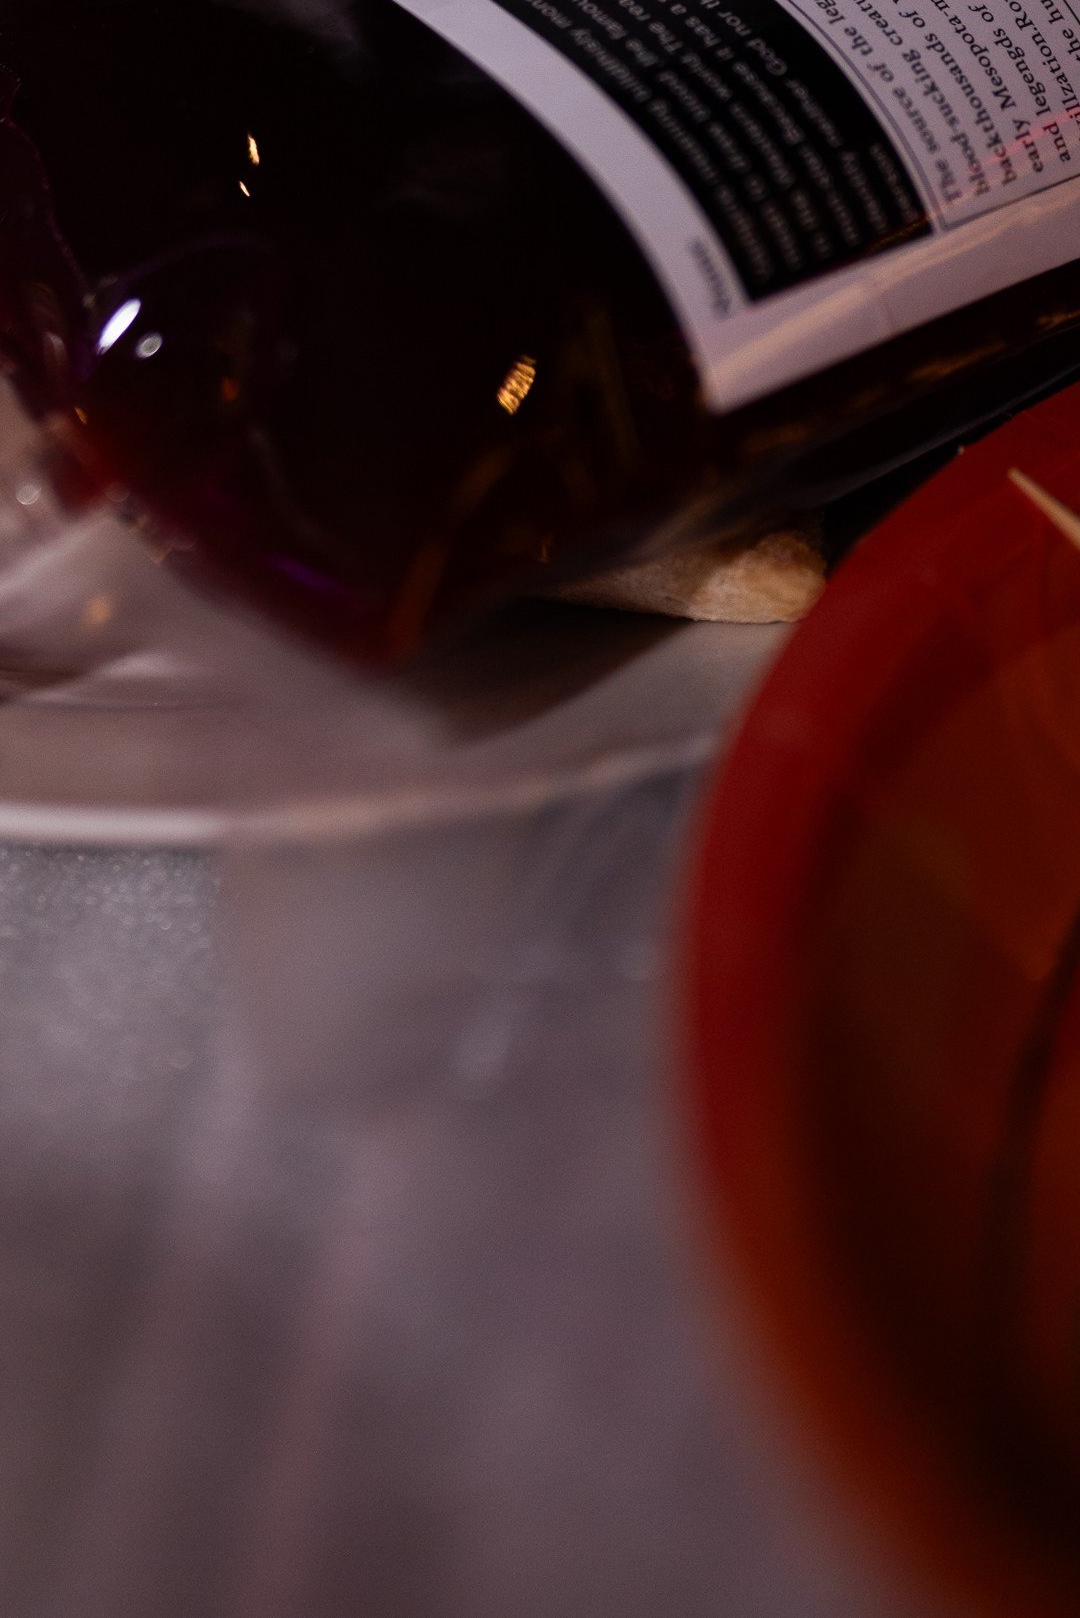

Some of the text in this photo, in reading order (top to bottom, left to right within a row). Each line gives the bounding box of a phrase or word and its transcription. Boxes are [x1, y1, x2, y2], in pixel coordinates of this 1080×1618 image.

[671, 4, 686, 14] a
[718, 12, 751, 36] nor
[899, 11, 925, 28] of
[968, 5, 994, 22] of
[685, 16, 719, 47] has
[844, 27, 873, 56] the
[746, 38, 787, 75] God
[867, 63, 894, 82] of
[993, 28, 1051, 116] legengds
[893, 88, 940, 154] source
[925, 33, 1017, 186] backthousands
[1013, 120, 1044, 173] early
[1043, 122, 1071, 163] and
[936, 160, 961, 203] The
